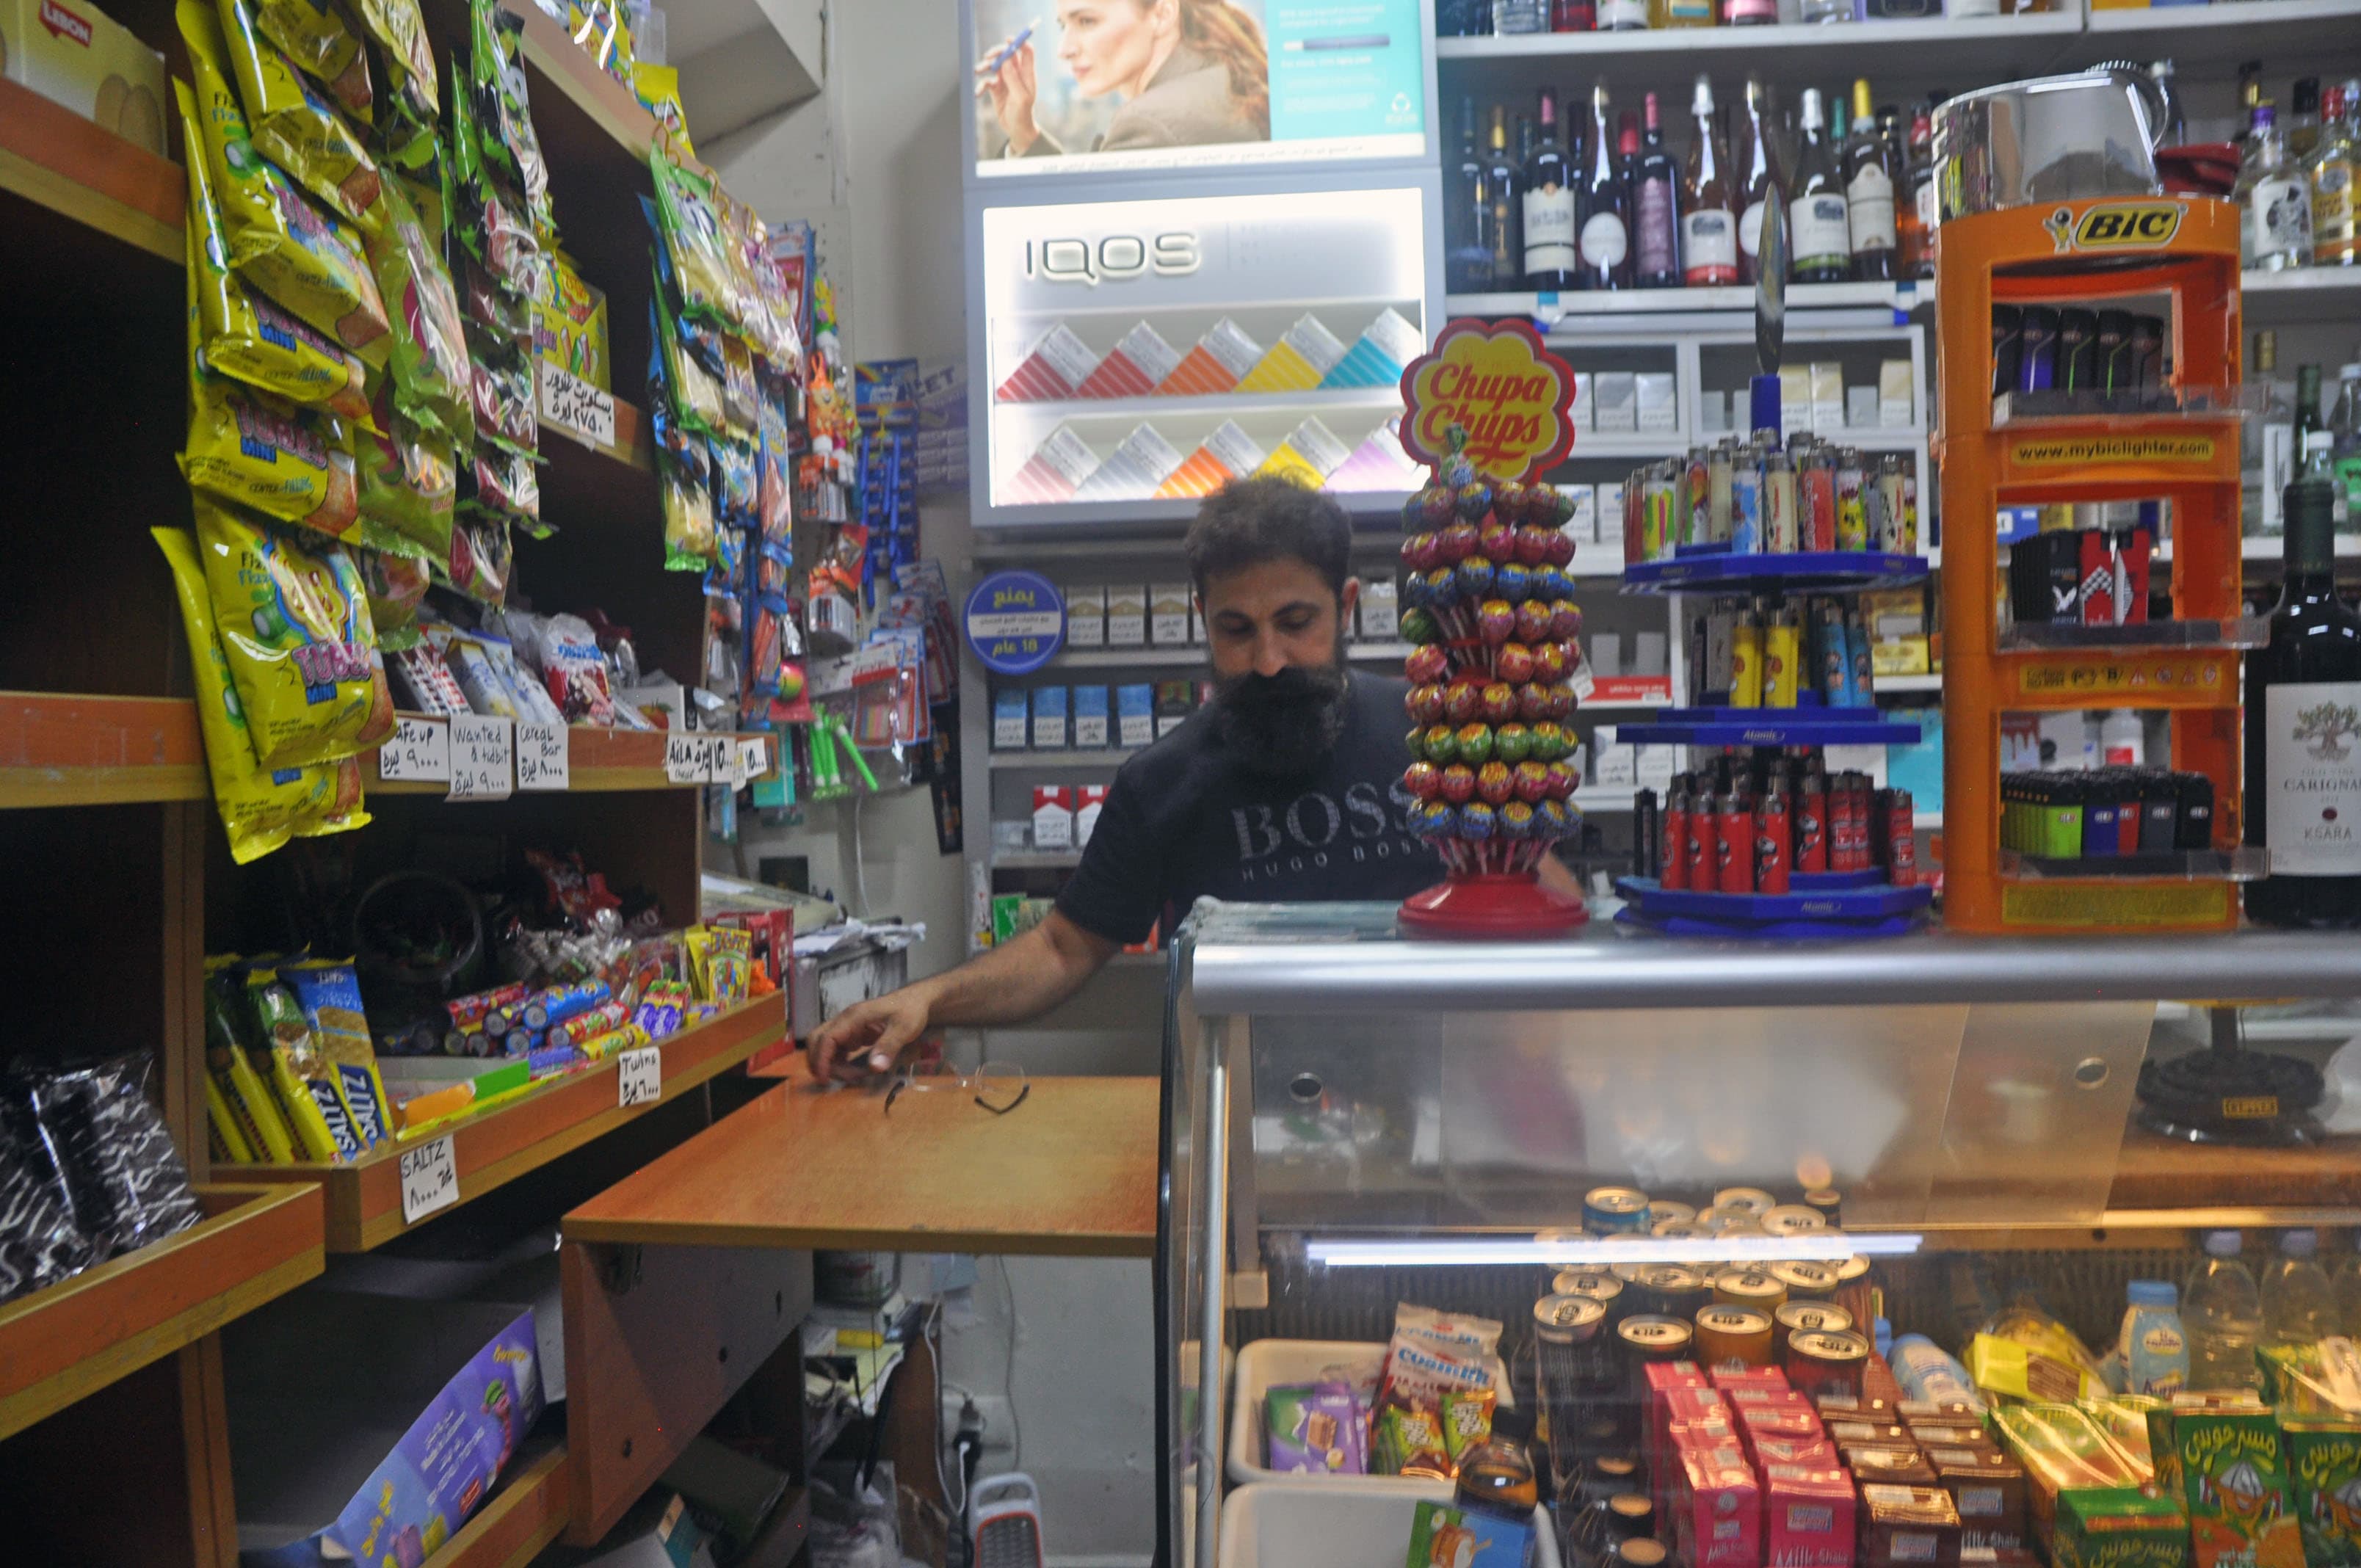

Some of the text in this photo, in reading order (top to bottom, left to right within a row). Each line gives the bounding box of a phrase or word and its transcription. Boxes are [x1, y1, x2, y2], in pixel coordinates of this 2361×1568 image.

[2084, 211, 2172, 239] BIC
[1026, 231, 1201, 284] IQOS
[1429, 362, 1550, 412] Chupa
[240, 435, 278, 464] MINI
[1422, 402, 1542, 468] Chups
[2019, 439, 2210, 460] www.mybiclighter.com
[454, 722, 501, 744] Wanted
[540, 742, 561, 758] Bar
[2304, 825, 2352, 841] KSARA
[311, 1086, 358, 1153] SALTZ
[341, 1072, 380, 1139] SALTZ
[401, 1140, 445, 1179] SALTZ
